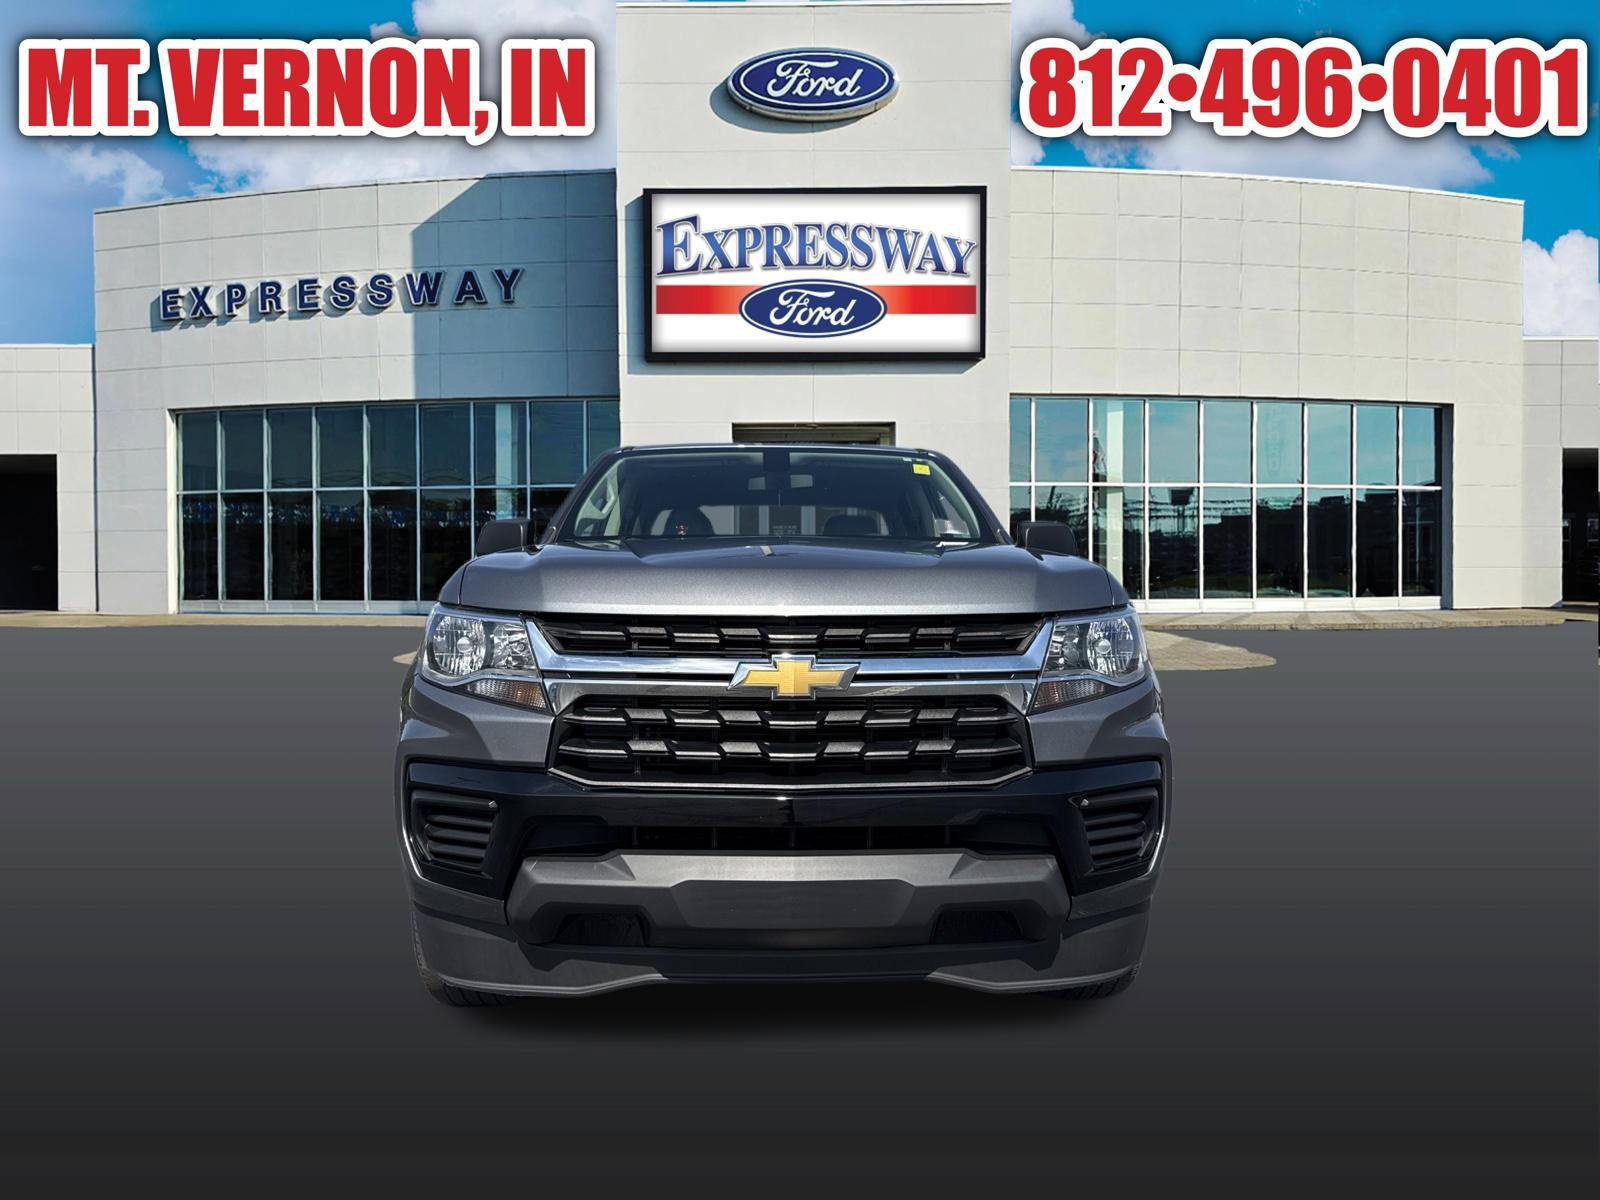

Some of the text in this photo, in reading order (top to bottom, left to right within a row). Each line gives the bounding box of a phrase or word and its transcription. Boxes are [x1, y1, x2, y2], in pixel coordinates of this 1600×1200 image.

[765, 58, 862, 97] Ford
[160, 268, 524, 321] EXPRESSWAY
[768, 288, 857, 327] Ford
